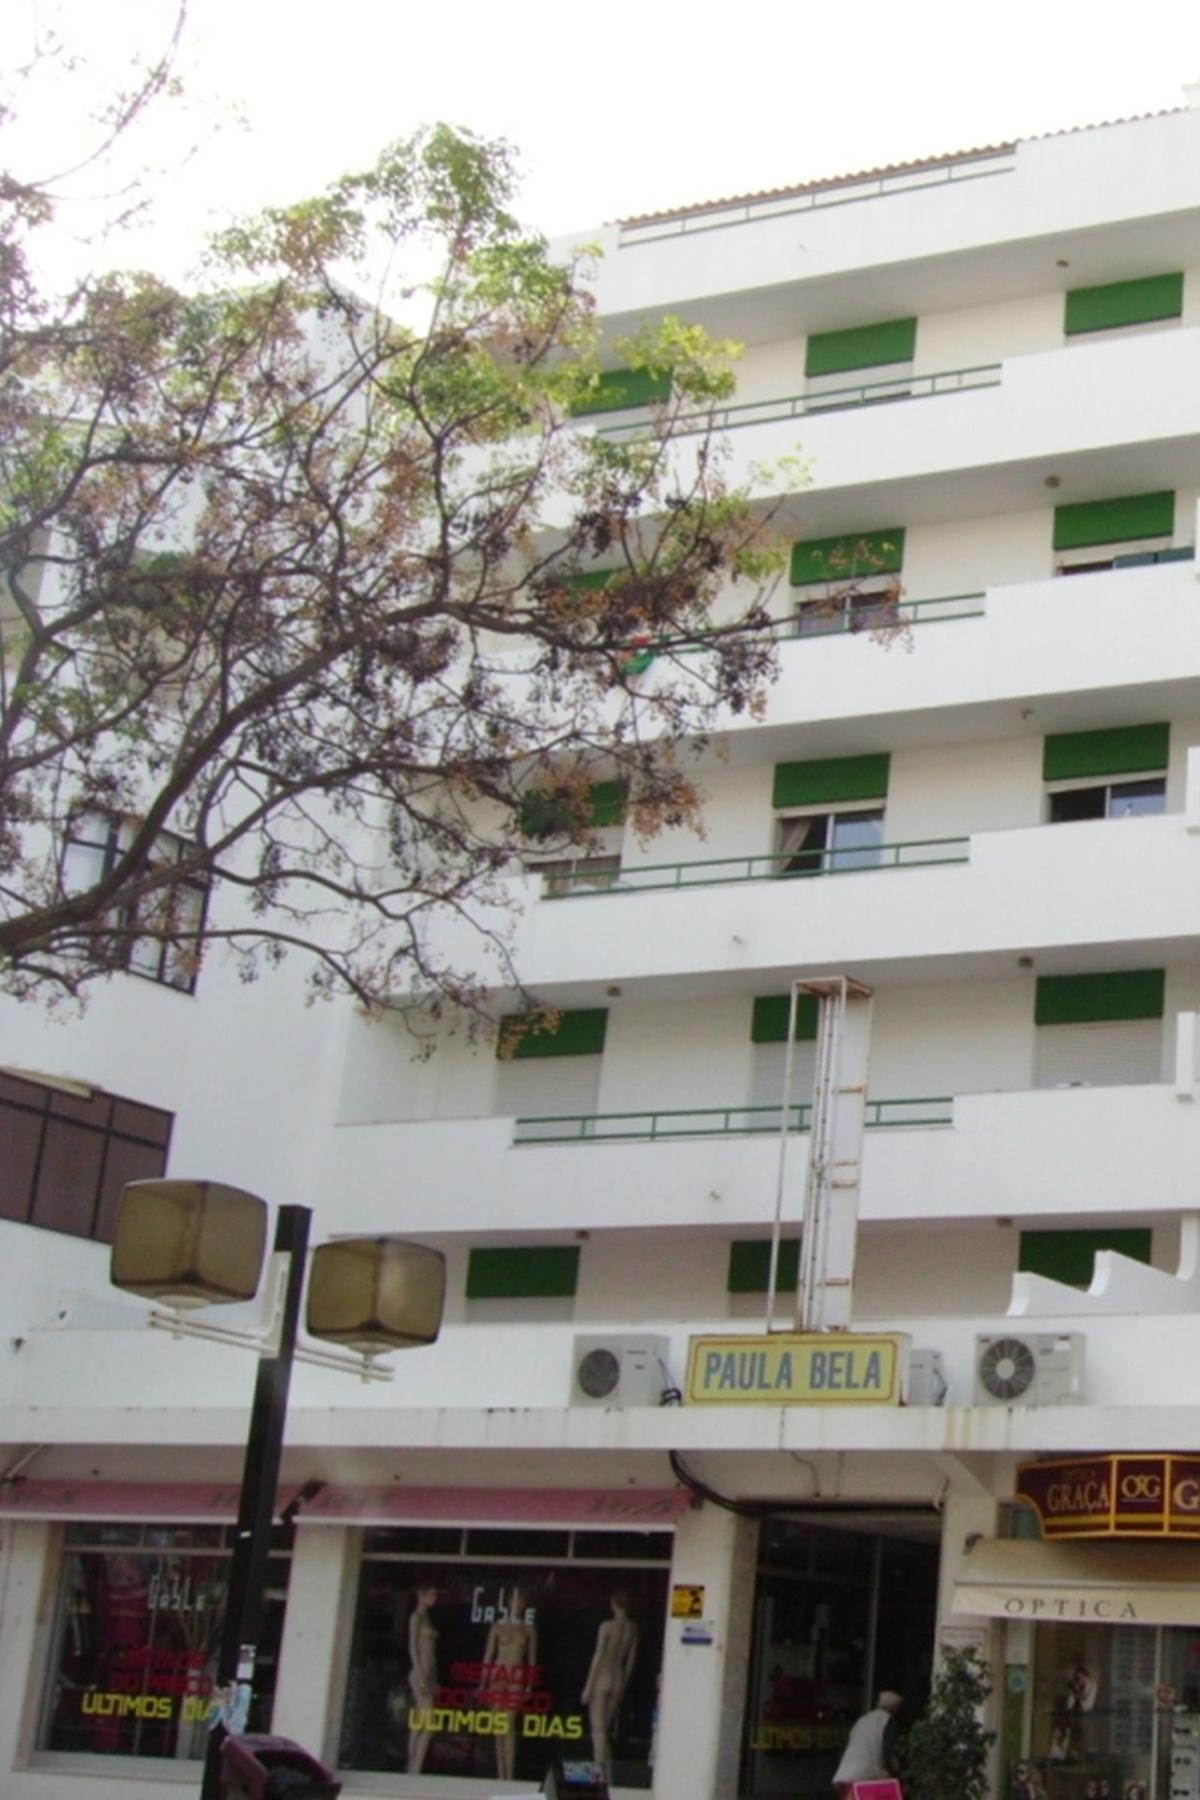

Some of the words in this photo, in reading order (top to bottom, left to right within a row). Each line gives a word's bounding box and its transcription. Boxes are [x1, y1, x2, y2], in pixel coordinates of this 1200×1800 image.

[703, 1351, 793, 1391] PAULA
[809, 1349, 882, 1390] BELA
[1046, 1480, 1110, 1513] GRAÇA
[1003, 1597, 1138, 1618] OPTICA
[81, 1691, 173, 1719] ULTIMOS
[407, 1707, 511, 1735] ULTIMOS
[522, 1713, 583, 1740] DIAS
